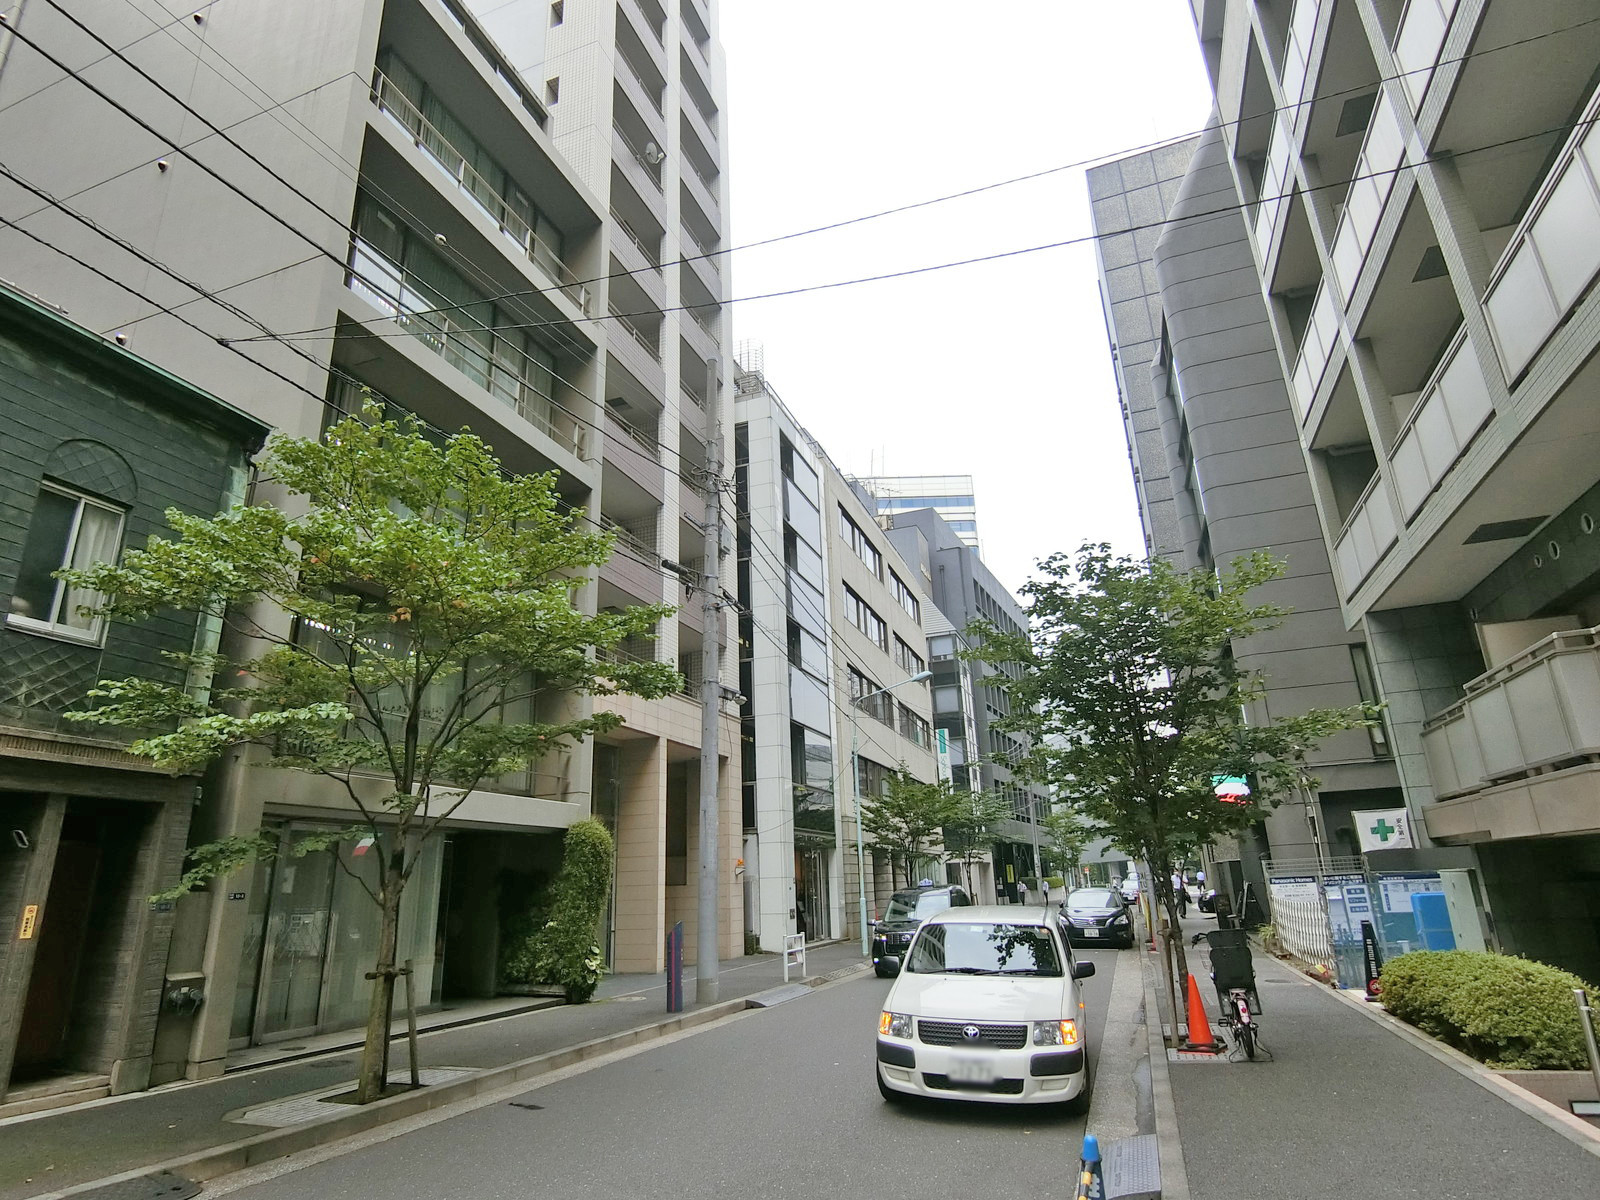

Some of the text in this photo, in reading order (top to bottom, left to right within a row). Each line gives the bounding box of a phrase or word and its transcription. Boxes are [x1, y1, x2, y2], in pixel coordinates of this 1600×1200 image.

[1396, 817, 1406, 840] 安全第一
[1367, 945, 1375, 961] BICYCLE
[1370, 961, 1378, 978] PARKING
